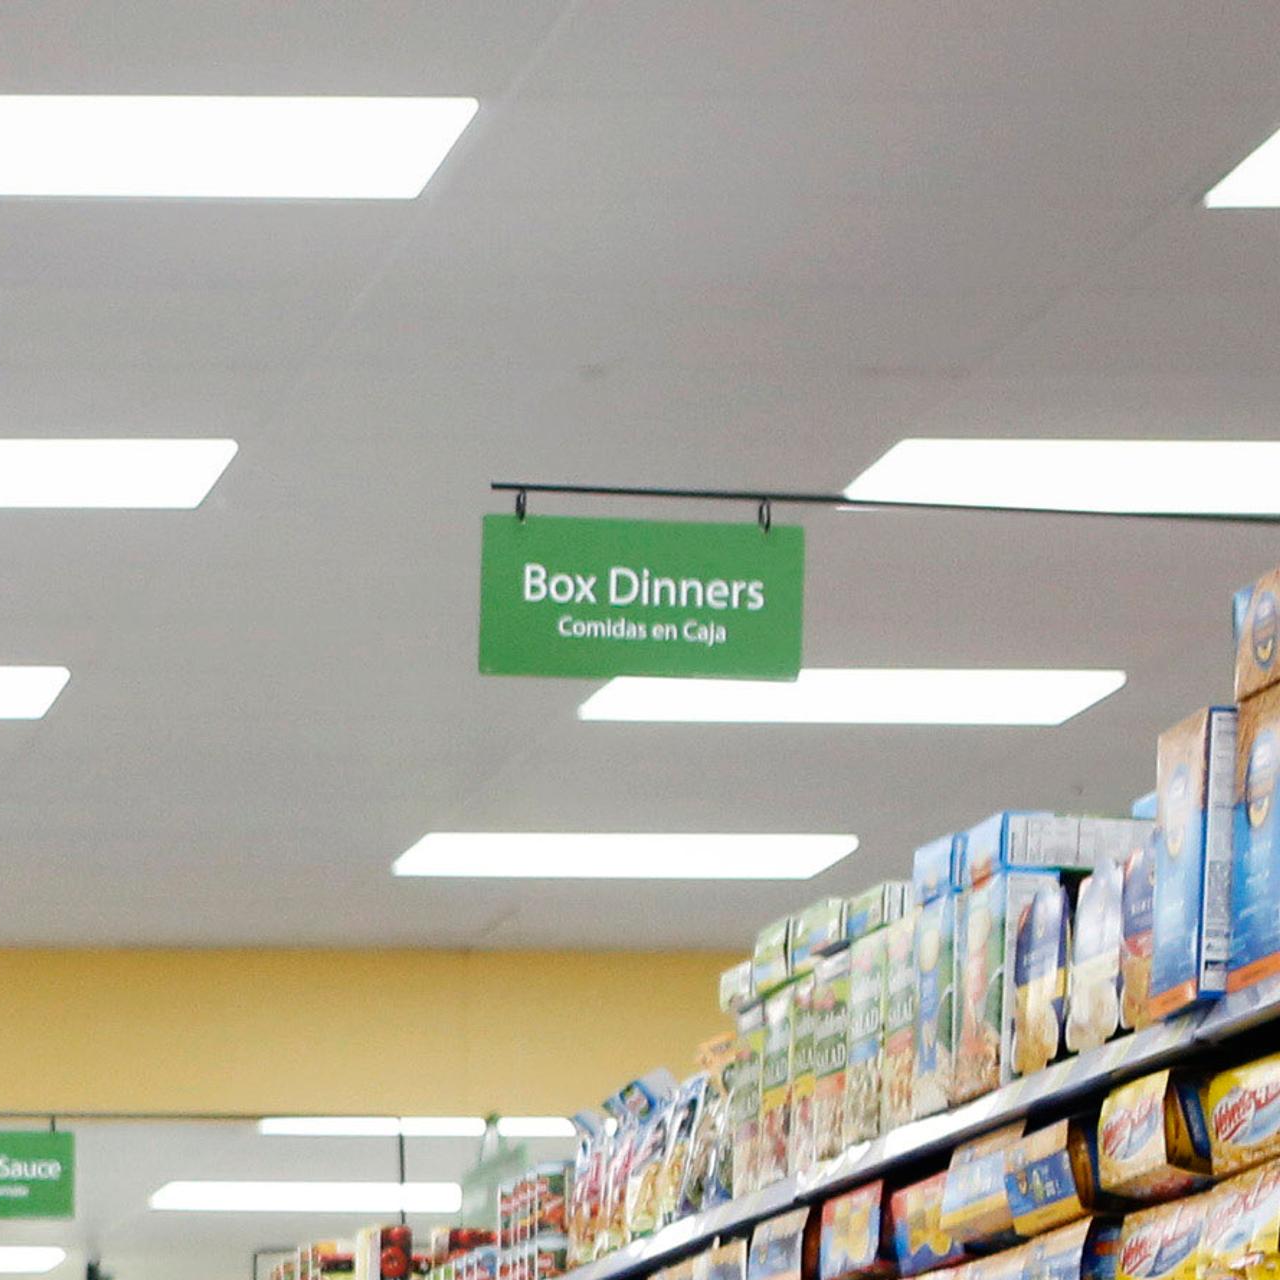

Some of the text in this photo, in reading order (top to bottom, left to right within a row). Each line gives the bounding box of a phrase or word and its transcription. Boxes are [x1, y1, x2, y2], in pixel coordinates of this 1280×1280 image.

[524, 564, 765, 609] Box Dinners
[558, 615, 727, 647] Comidas en Caja
